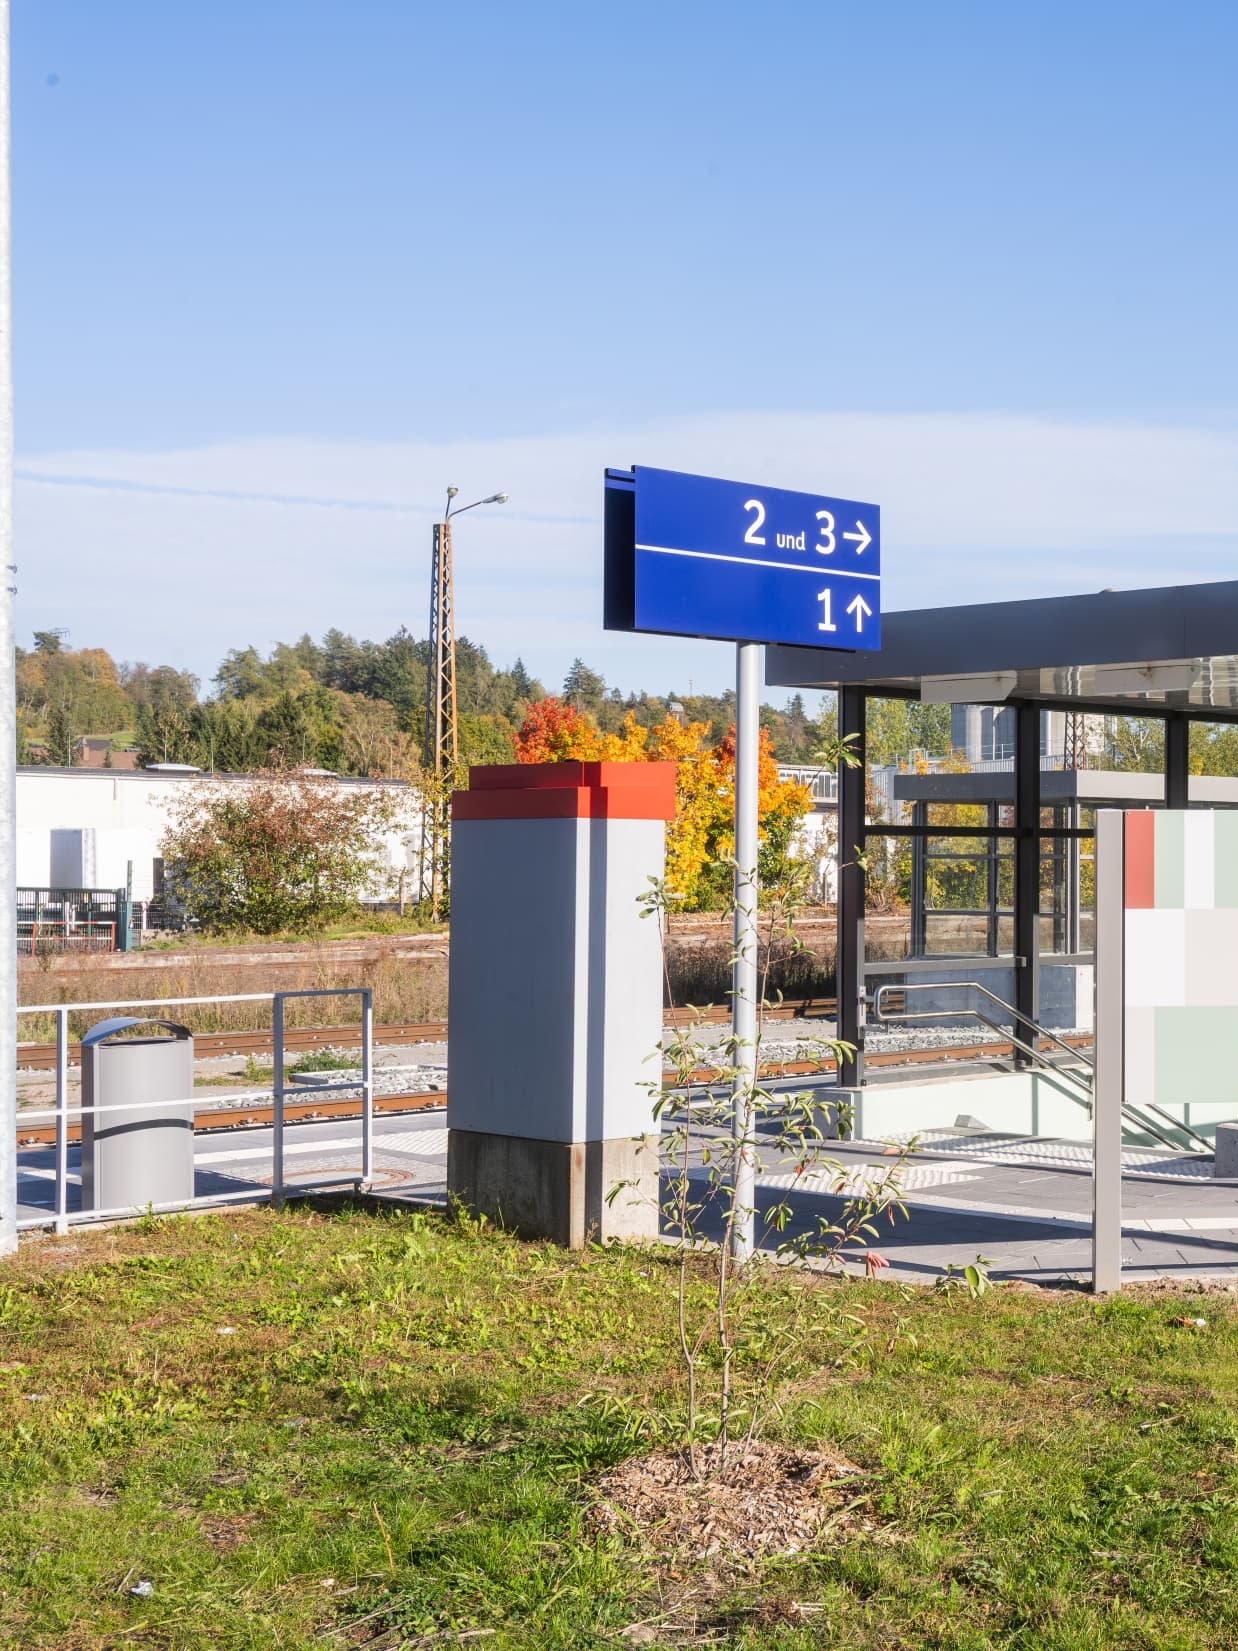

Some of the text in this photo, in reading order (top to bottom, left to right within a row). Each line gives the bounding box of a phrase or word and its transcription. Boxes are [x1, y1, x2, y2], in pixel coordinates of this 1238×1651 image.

[743, 499, 836, 555] 2 und 3
[817, 588, 837, 632] 1
